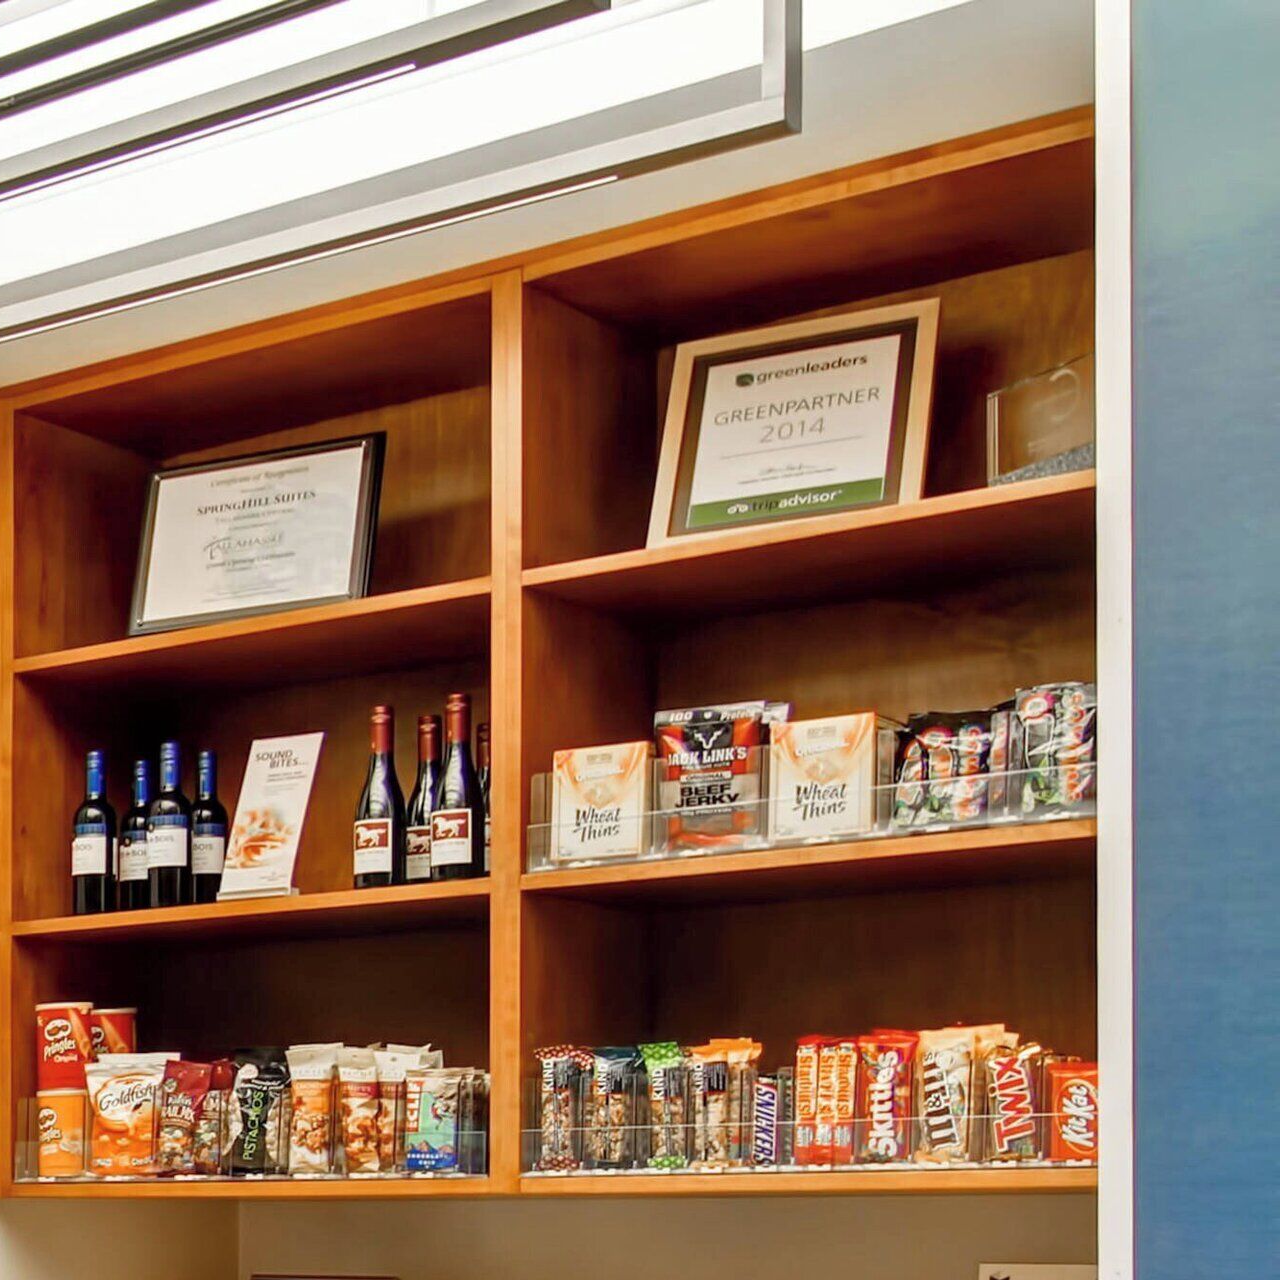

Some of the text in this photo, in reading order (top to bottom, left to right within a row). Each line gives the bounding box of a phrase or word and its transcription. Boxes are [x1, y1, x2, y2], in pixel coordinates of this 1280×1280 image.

[755, 353, 869, 386] greenleaders
[713, 386, 881, 428] GREENPARTNER
[759, 416, 827, 445] 2014
[197, 489, 316, 515] SPRINGHILL SUITES
[751, 489, 839, 514] tripadvisor
[255, 749, 293, 762] SOUND
[702, 746, 747, 764] LINK'S
[675, 793, 740, 808] JERKY
[680, 783, 732, 797] BEEF
[794, 782, 848, 804] Wheat
[575, 807, 621, 825] Wheat
[792, 801, 846, 821] Thins
[573, 825, 621, 844] Thins
[43, 1037, 77, 1063] Pringles
[542, 1059, 555, 1093] KIND
[596, 1063, 609, 1096] KIND
[652, 1067, 665, 1100] KIND
[693, 1062, 705, 1094] KIND
[99, 1083, 159, 1112] Goldfish
[868, 1050, 900, 1157] Skittles
[754, 1085, 777, 1168] SNICKERS
